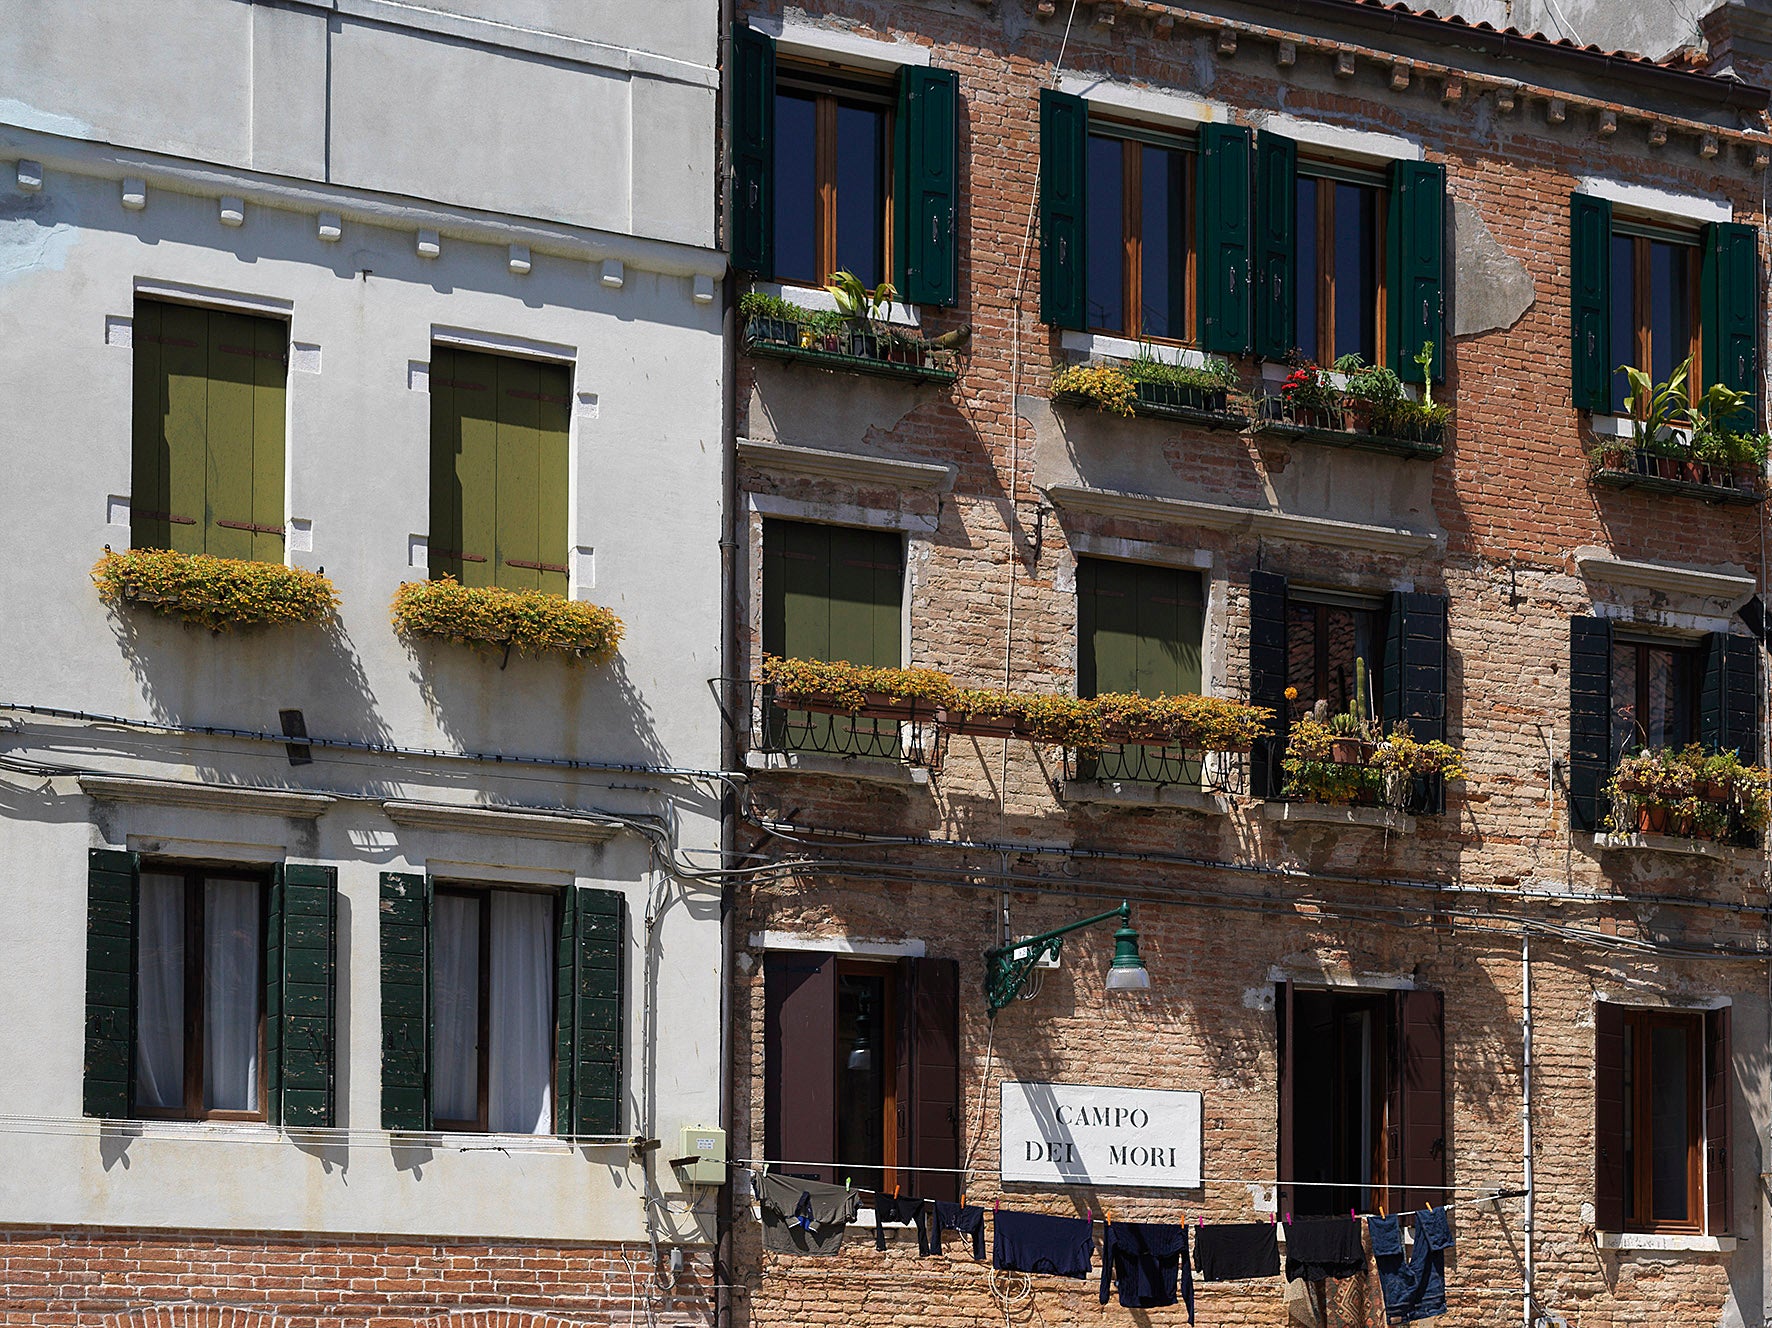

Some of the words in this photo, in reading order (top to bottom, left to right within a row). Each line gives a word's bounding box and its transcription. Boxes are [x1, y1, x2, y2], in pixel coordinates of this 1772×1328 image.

[1055, 1104, 1149, 1129] CAMPO
[1025, 1140, 1074, 1164] DEI
[1109, 1145, 1177, 1168] MORI
